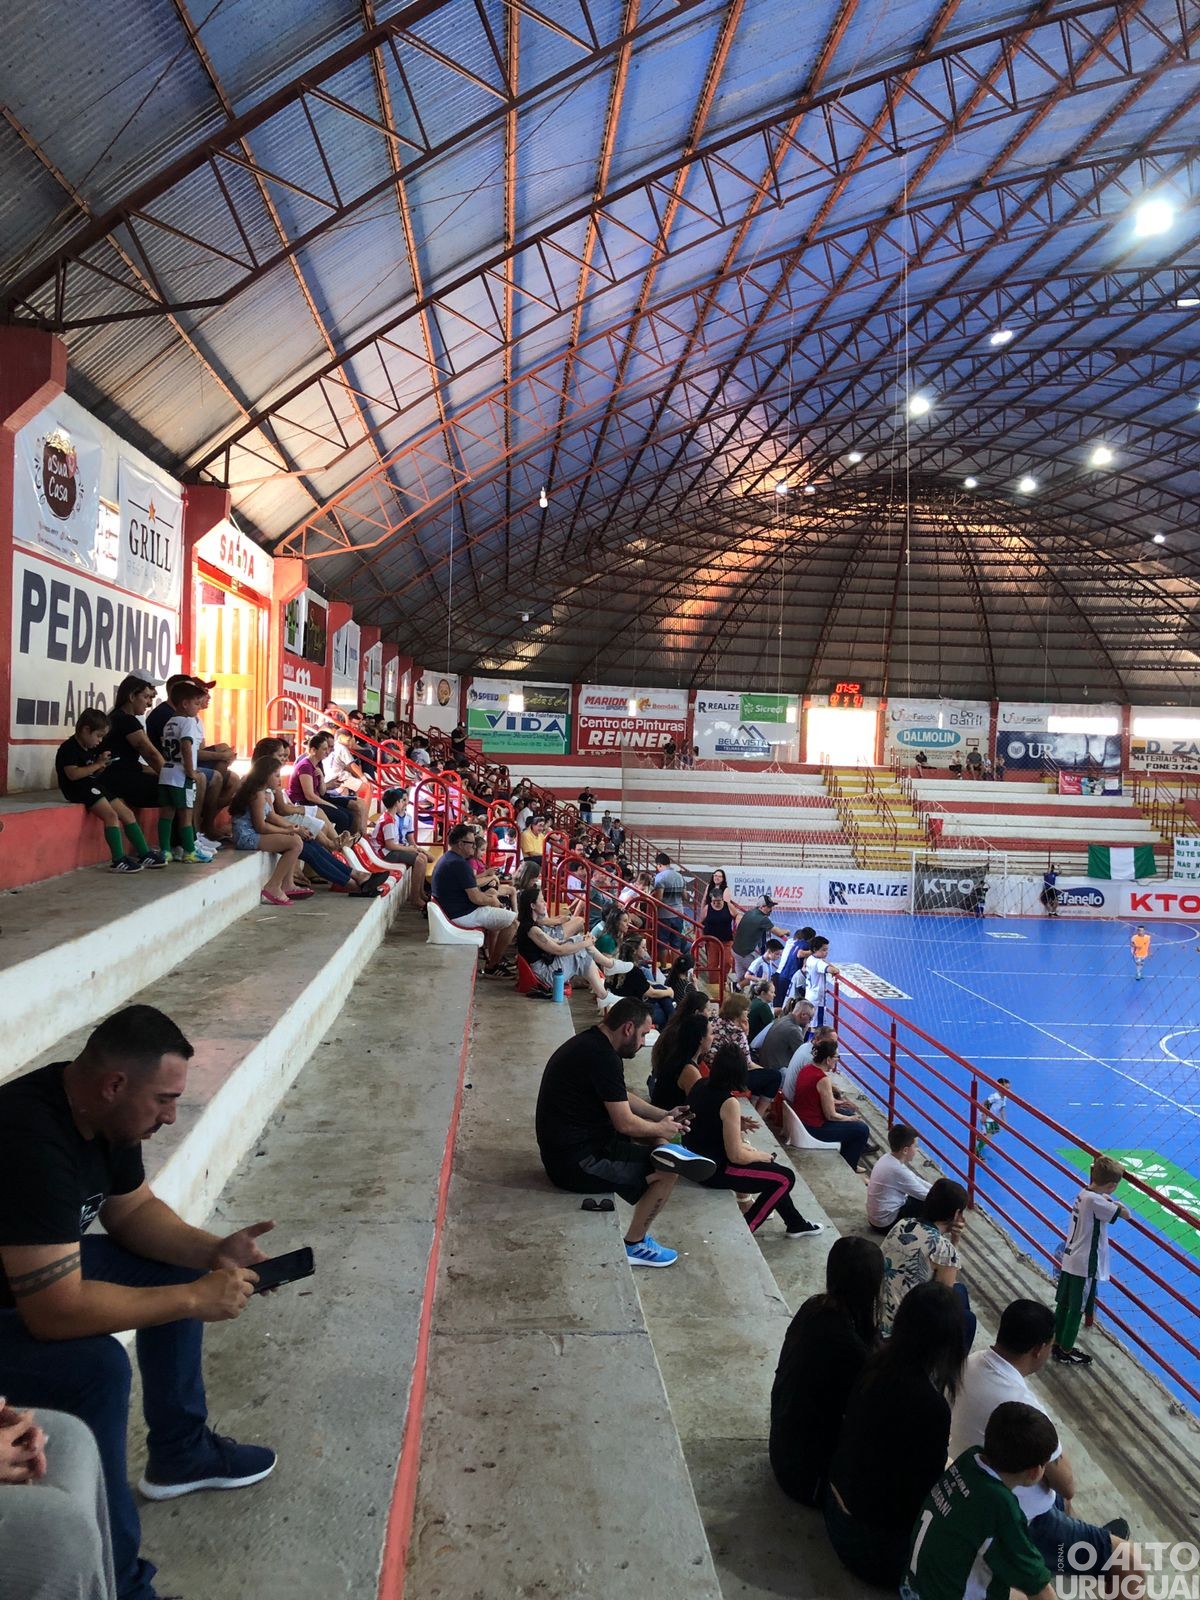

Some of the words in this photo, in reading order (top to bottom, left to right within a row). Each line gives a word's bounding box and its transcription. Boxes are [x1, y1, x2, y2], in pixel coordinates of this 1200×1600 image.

[48, 477, 68, 503] Casa
[128, 518, 172, 573] GRILL
[19, 568, 171, 680] PEDRINHO
[584, 696, 627, 706] MARION
[708, 702, 740, 711] REALIZE
[755, 704, 784, 714] Sicredi
[485, 710, 566, 741] VIDA
[580, 717, 619, 728] Centro
[621, 719, 634, 729] de
[636, 719, 684, 732] Pinturas
[588, 730, 672, 748] RENNER
[718, 737, 740, 746] BELA
[743, 739, 768, 747] VISTA
[903, 730, 955, 743] DALMOLIN
[1133, 754, 1177, 762] MATERIAIS
[848, 883, 908, 897] REALIZE
[923, 878, 973, 894] KTO
[1131, 892, 1200, 914] KTO
